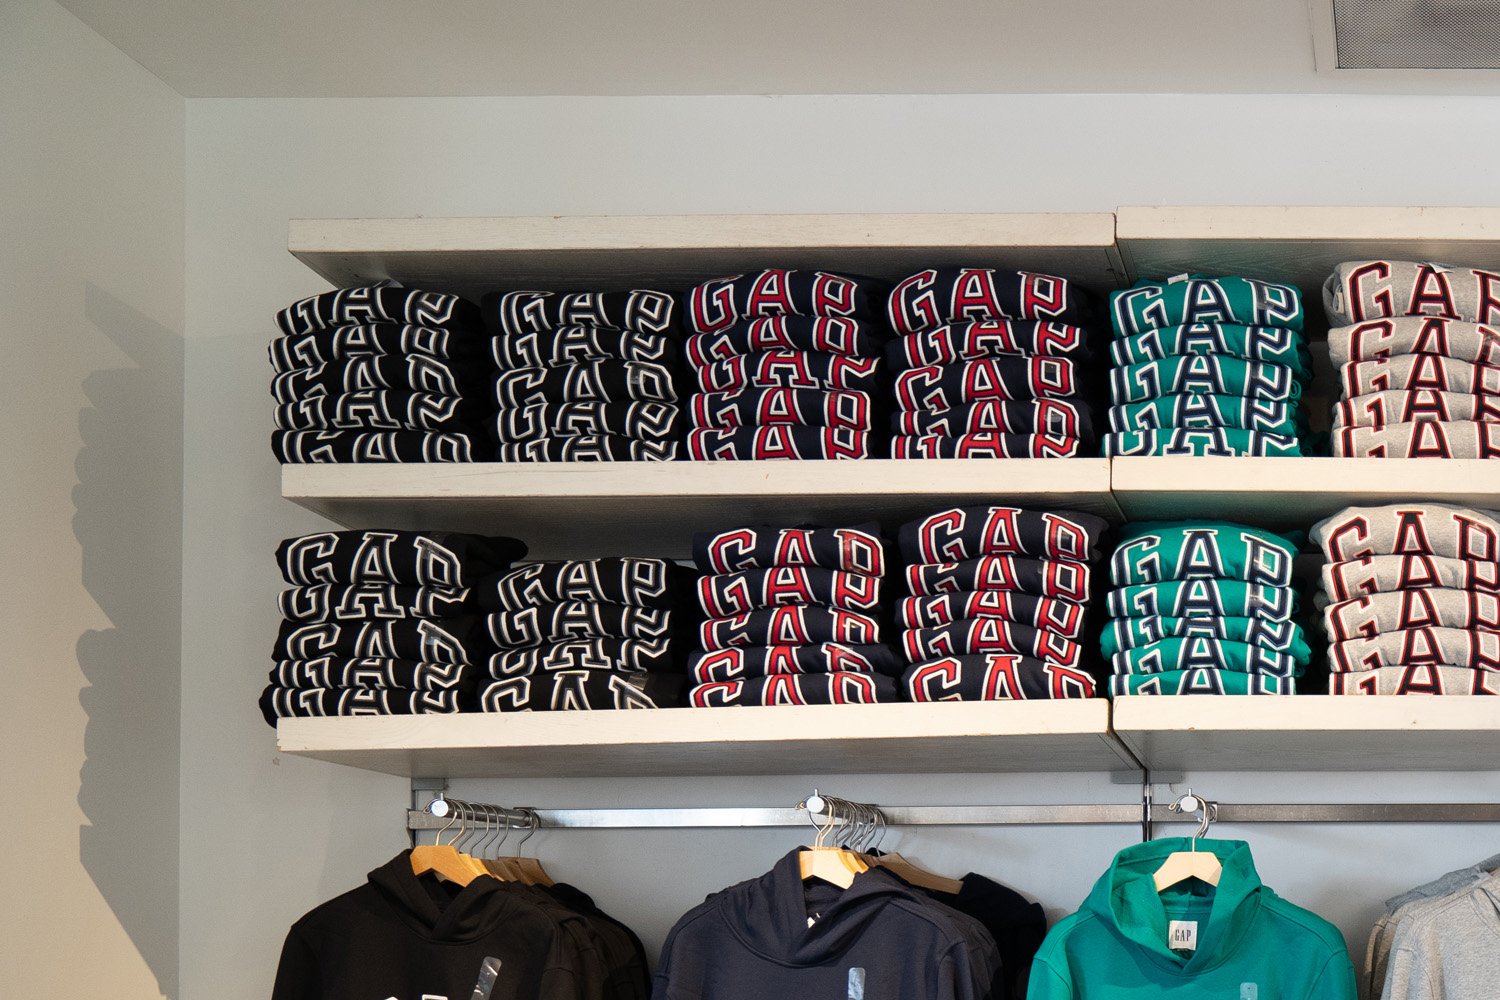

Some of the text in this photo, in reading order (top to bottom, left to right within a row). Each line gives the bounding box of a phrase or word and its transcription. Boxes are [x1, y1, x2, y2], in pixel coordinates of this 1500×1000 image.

[888, 269, 1067, 336] GAP
[1111, 529, 1293, 586] GAP
[1176, 929, 1192, 941] GAP
